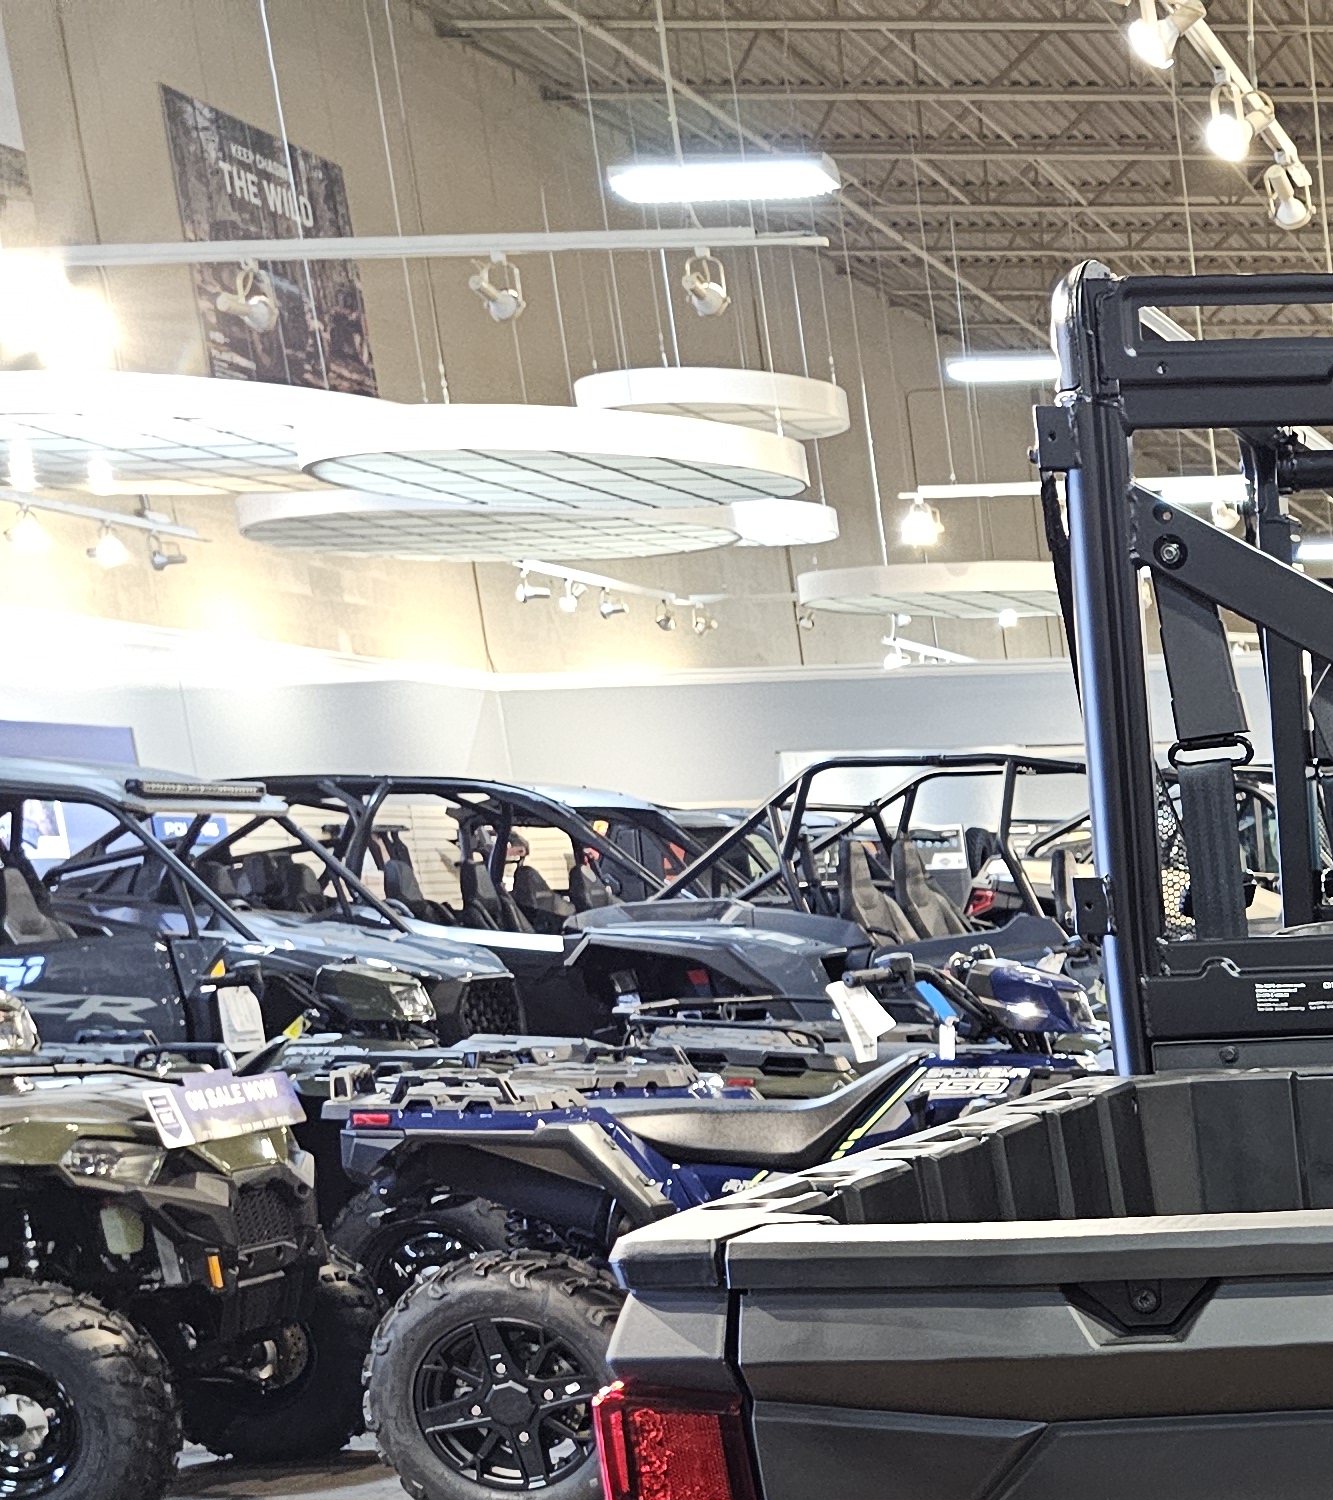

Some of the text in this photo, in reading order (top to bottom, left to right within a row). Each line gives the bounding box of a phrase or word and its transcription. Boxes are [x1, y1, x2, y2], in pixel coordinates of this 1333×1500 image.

[219, 160, 313, 228] THE WILD
[15, 990, 158, 1023] ZR
[184, 1077, 279, 1111] ON SALE NOW
